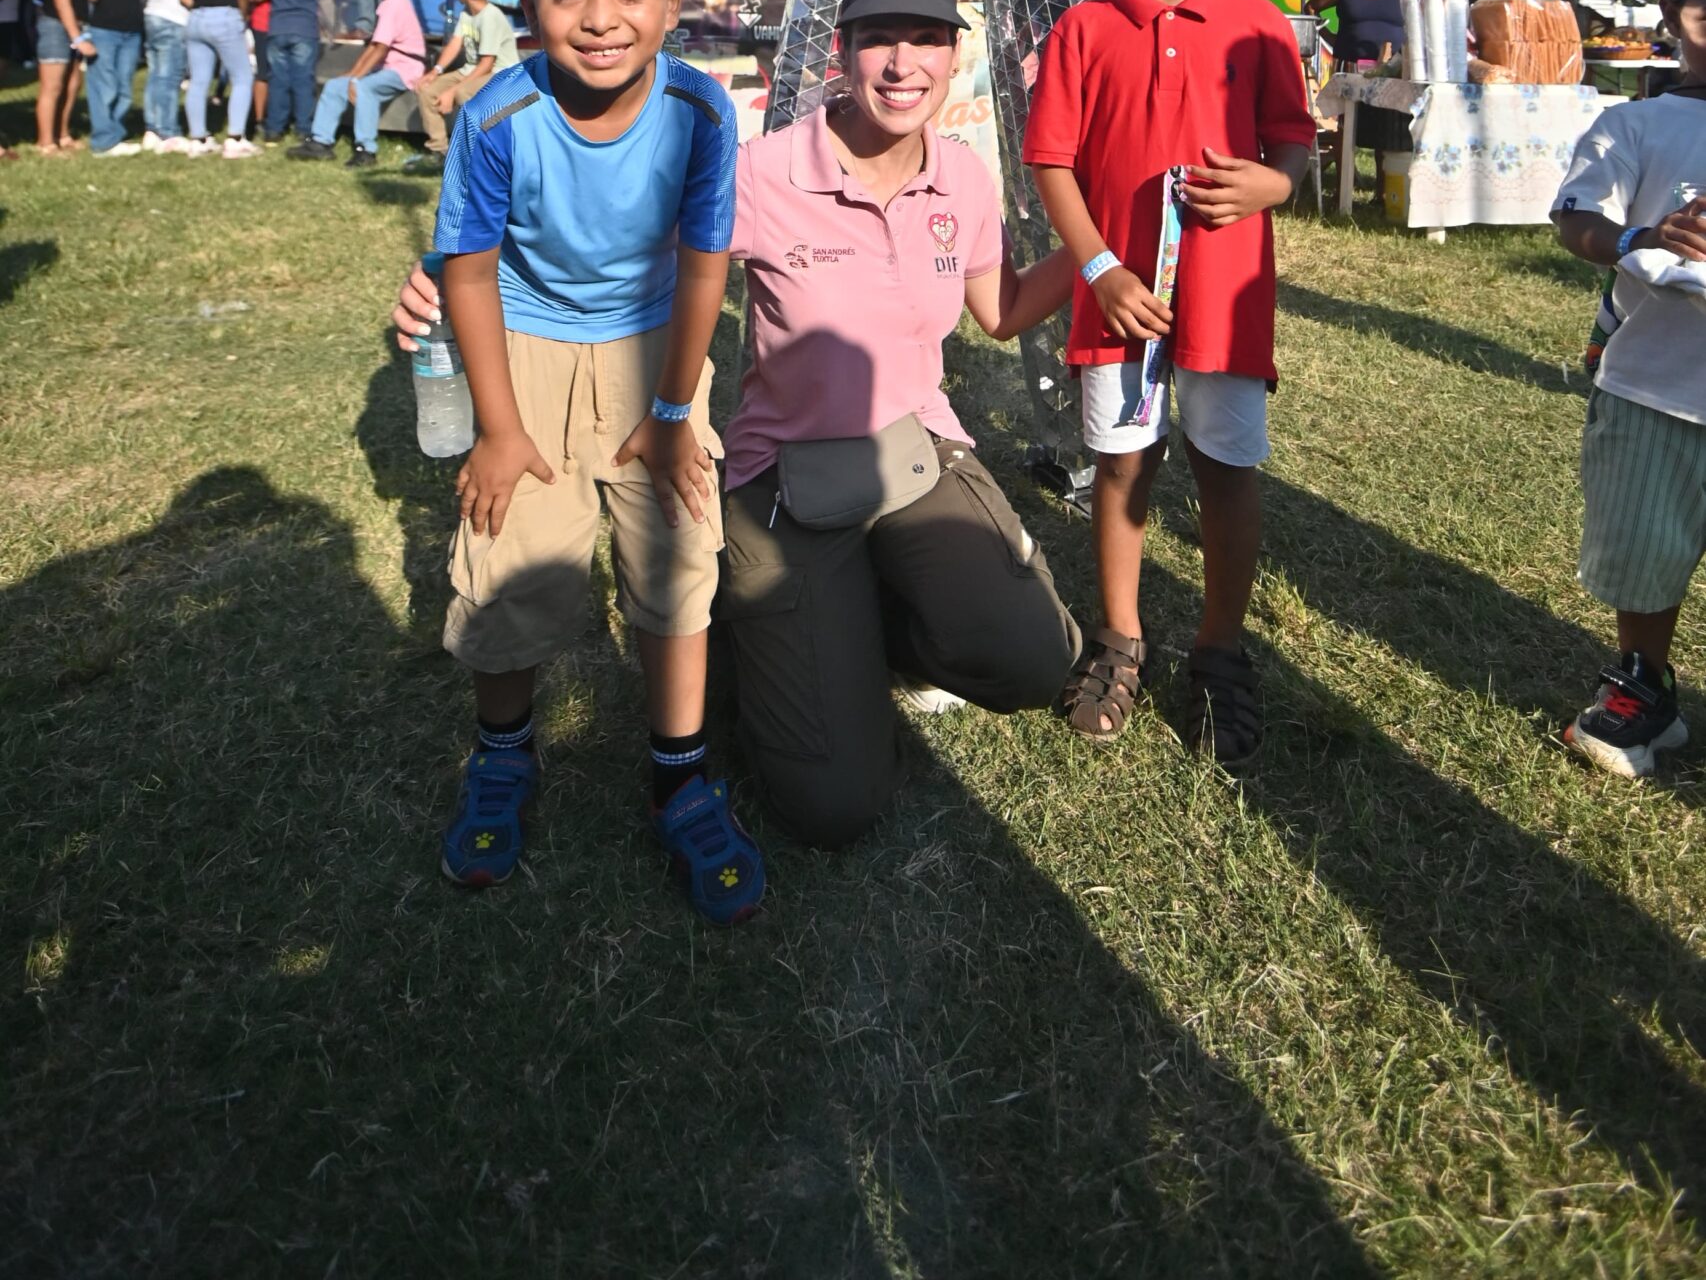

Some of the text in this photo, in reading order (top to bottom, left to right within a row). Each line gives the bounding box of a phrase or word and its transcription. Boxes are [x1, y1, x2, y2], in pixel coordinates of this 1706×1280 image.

[812, 246, 856, 256] SAN ANDRÉS
[934, 256, 959, 272] DIF
